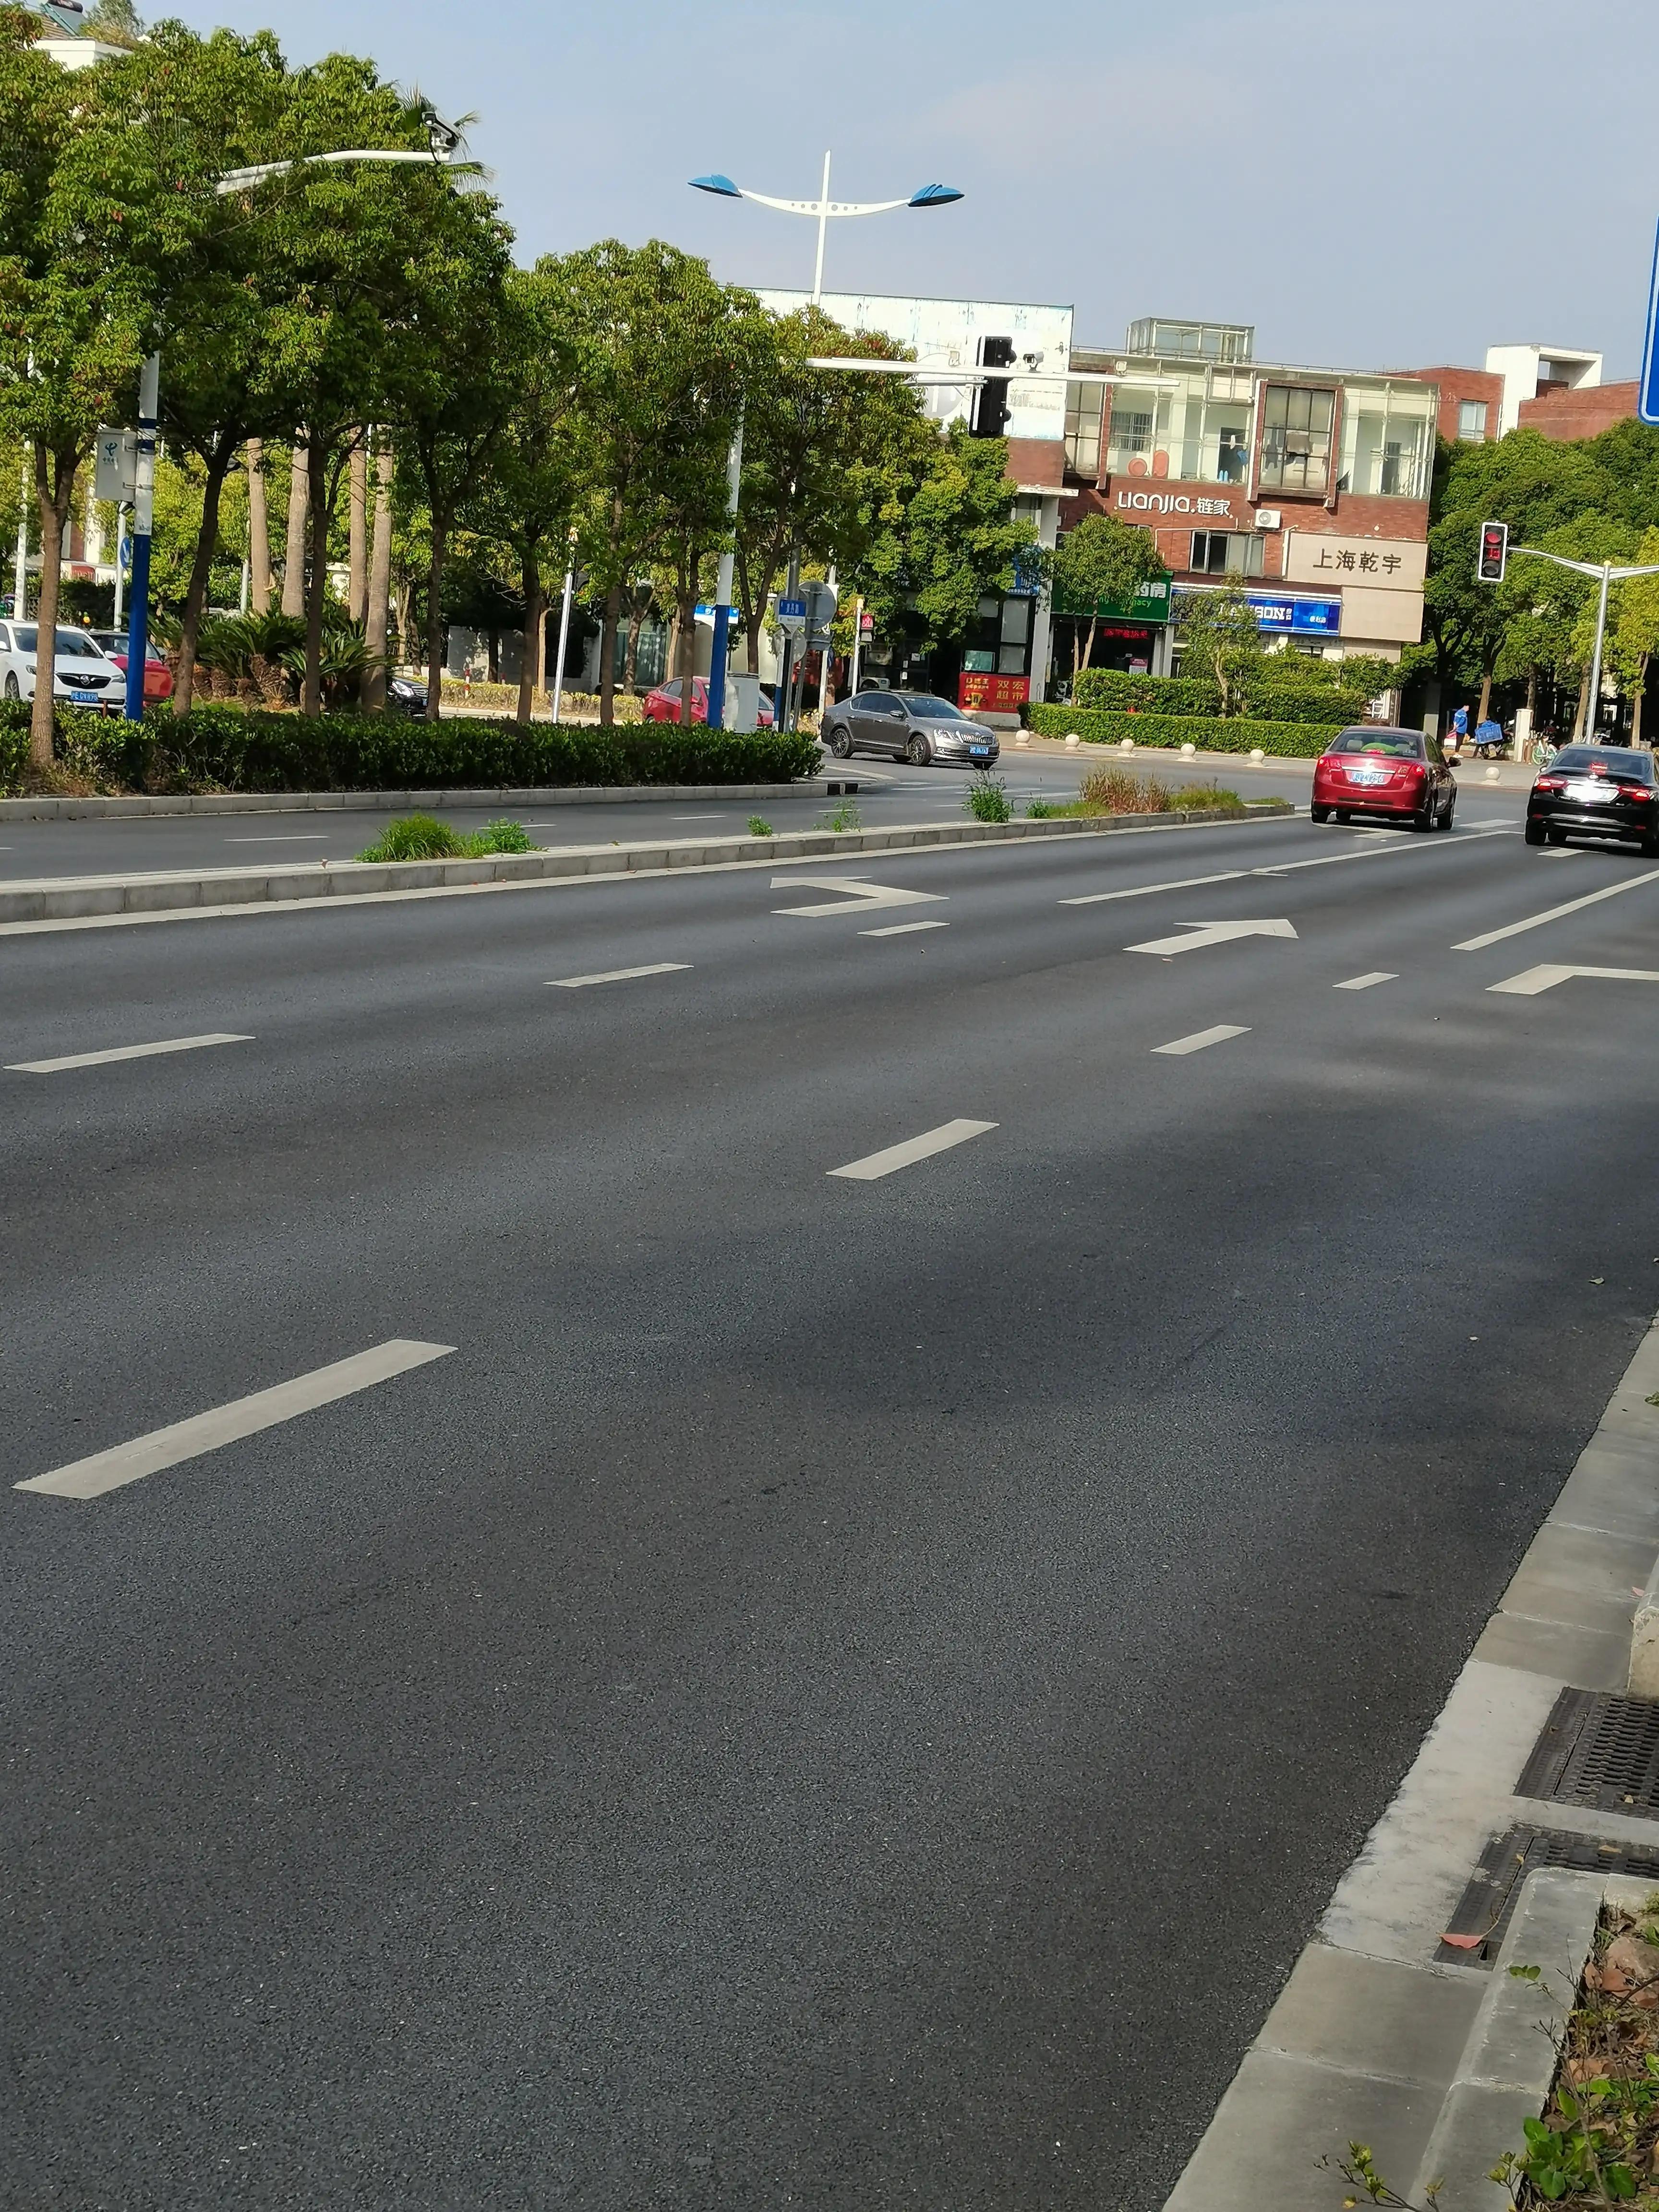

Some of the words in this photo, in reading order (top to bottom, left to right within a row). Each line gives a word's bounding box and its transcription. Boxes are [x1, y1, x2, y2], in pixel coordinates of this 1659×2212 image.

[1197, 497, 1230, 516] 链家
[1312, 548, 1402, 575] 上海乾宇
[997, 690, 1024, 700] 超市
